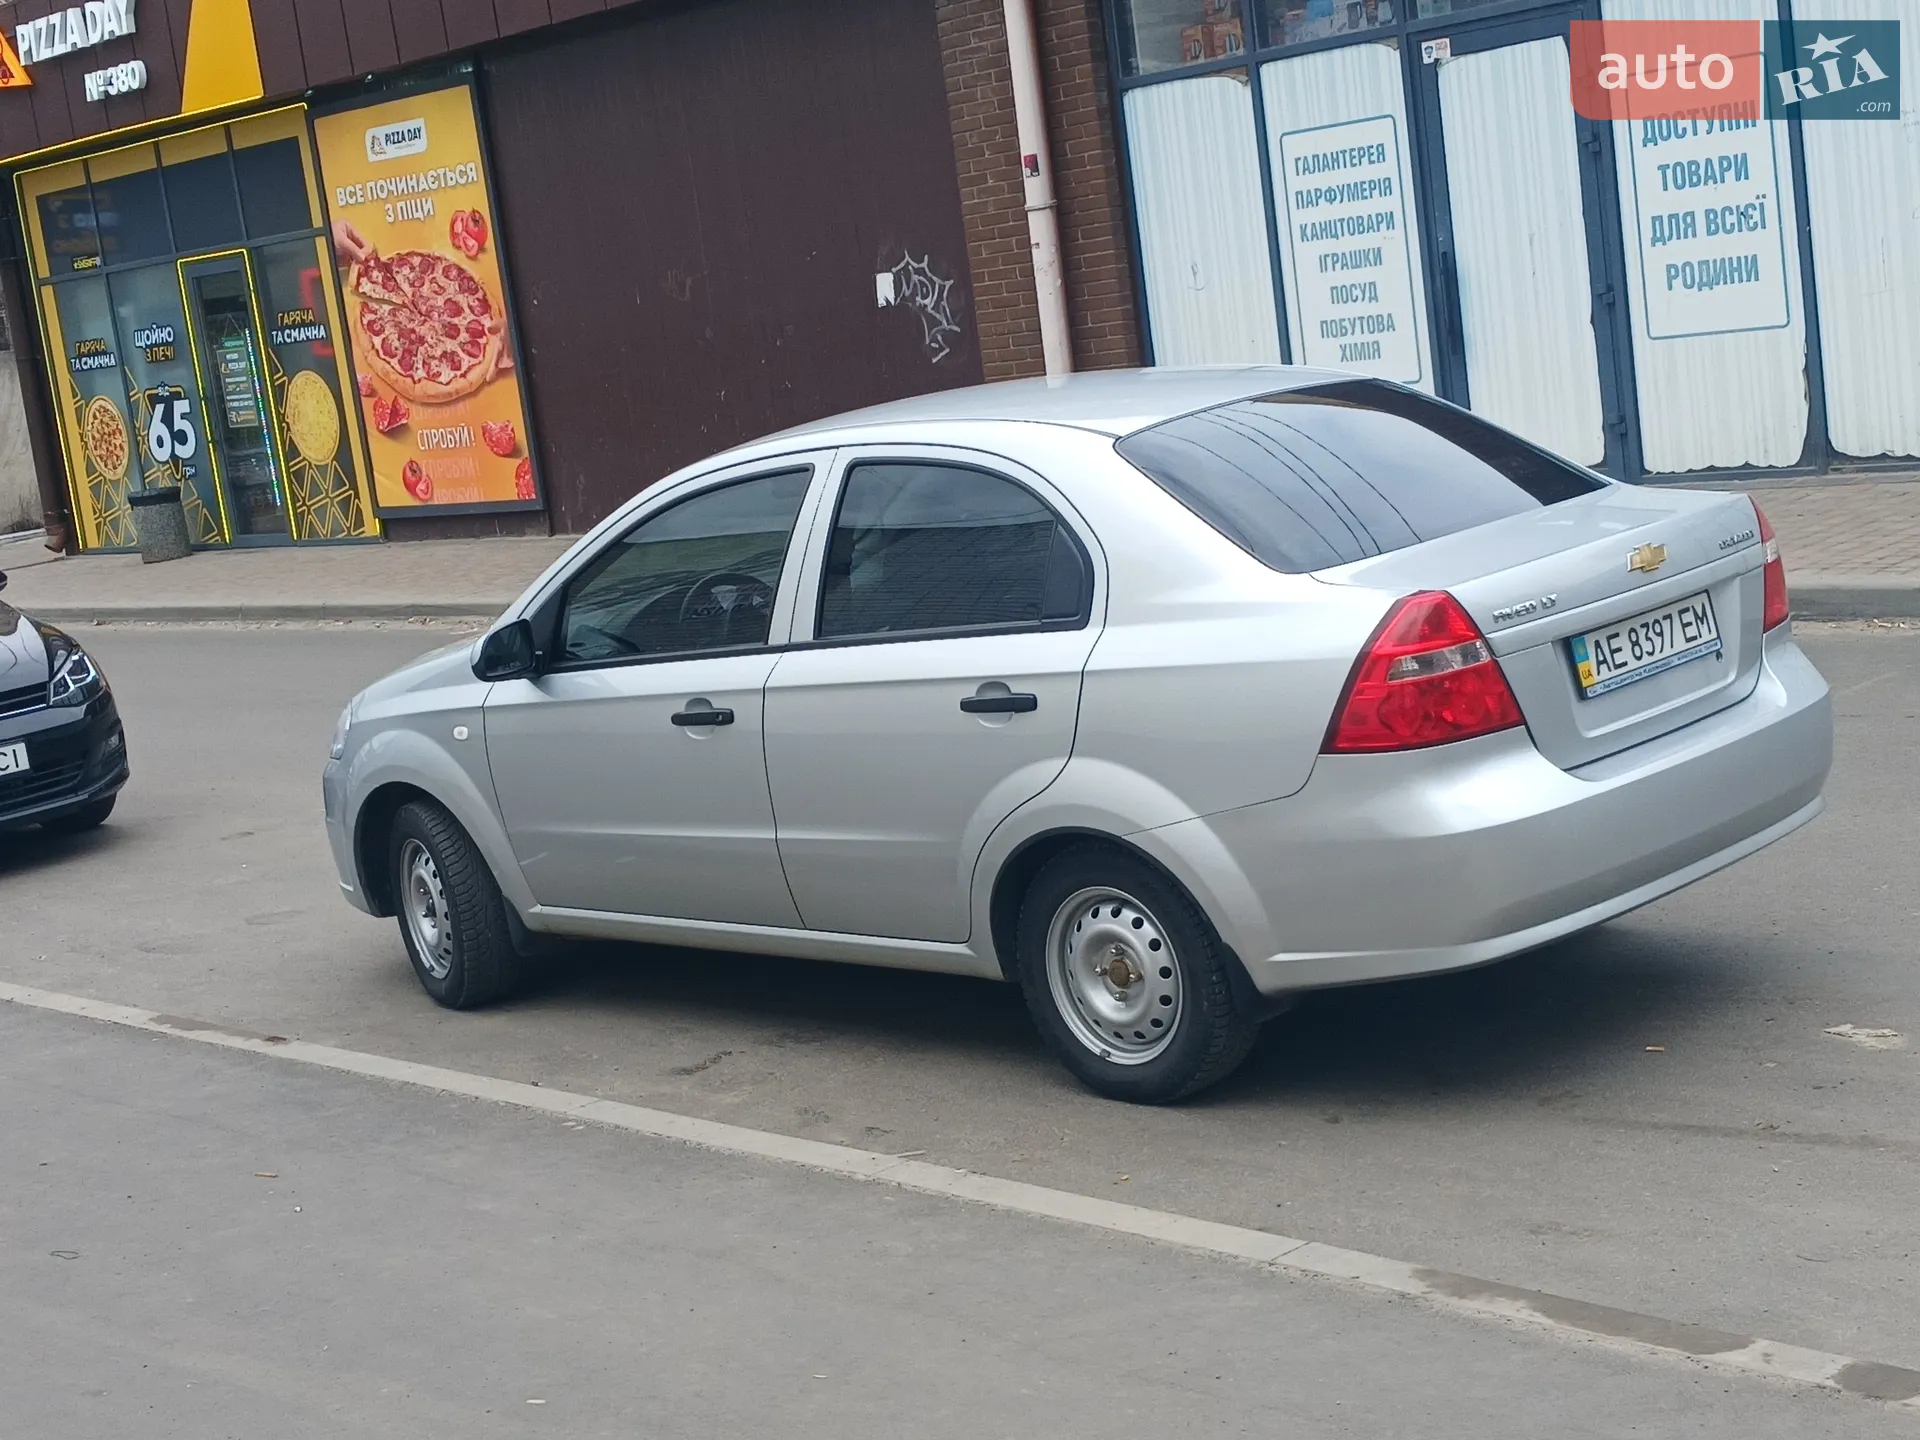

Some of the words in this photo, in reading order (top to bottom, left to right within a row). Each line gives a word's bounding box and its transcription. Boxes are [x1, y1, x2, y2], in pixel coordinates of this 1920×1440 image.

[16, 7, 90, 66] PIZZA
[84, 0, 136, 46] DAY
[384, 131, 406, 147] PIZZA
[408, 126, 422, 141] DAY
[1642, 100, 1757, 148] ДОСТУПНІ
[1294, 143, 1386, 176] ГАЛАНТЕРЕЯ
[1657, 152, 1749, 191] ТОВАРИ
[336, 183, 365, 207] ВСЕ
[366, 162, 478, 200] ПОЧИНАЄТЬСЯ
[1295, 177, 1392, 210] ПАРФУМЕРІЯ
[397, 198, 434, 221] ПІЦИ
[1650, 210, 1697, 247] ДЛЯ
[1704, 193, 1767, 237] ВСІЄЇ
[1300, 211, 1395, 243] КАНЦТОВАРИ
[1319, 246, 1383, 273] ІГРАШКИ
[1666, 254, 1760, 291] РОДИНИ
[1330, 281, 1379, 304] ПОСУД
[278, 308, 315, 327] ГАРЯЧА
[1320, 313, 1396, 339] ПОБУТОВА
[134, 323, 174, 348] ЩОЙНО
[284, 324, 327, 343] СМАЧНА
[75, 339, 107, 355] ГАРЯЧА
[153, 349, 174, 361] ПЕЧІ
[1339, 340, 1381, 363] ХІМІЯ
[82, 353, 116, 370] СМАЧНА
[150, 398, 196, 462] 65
[1593, 632, 1628, 676] AE
[1628, 613, 1674, 661] 8397
[1678, 602, 1712, 643] EM
[1581, 668, 1593, 680] UA
